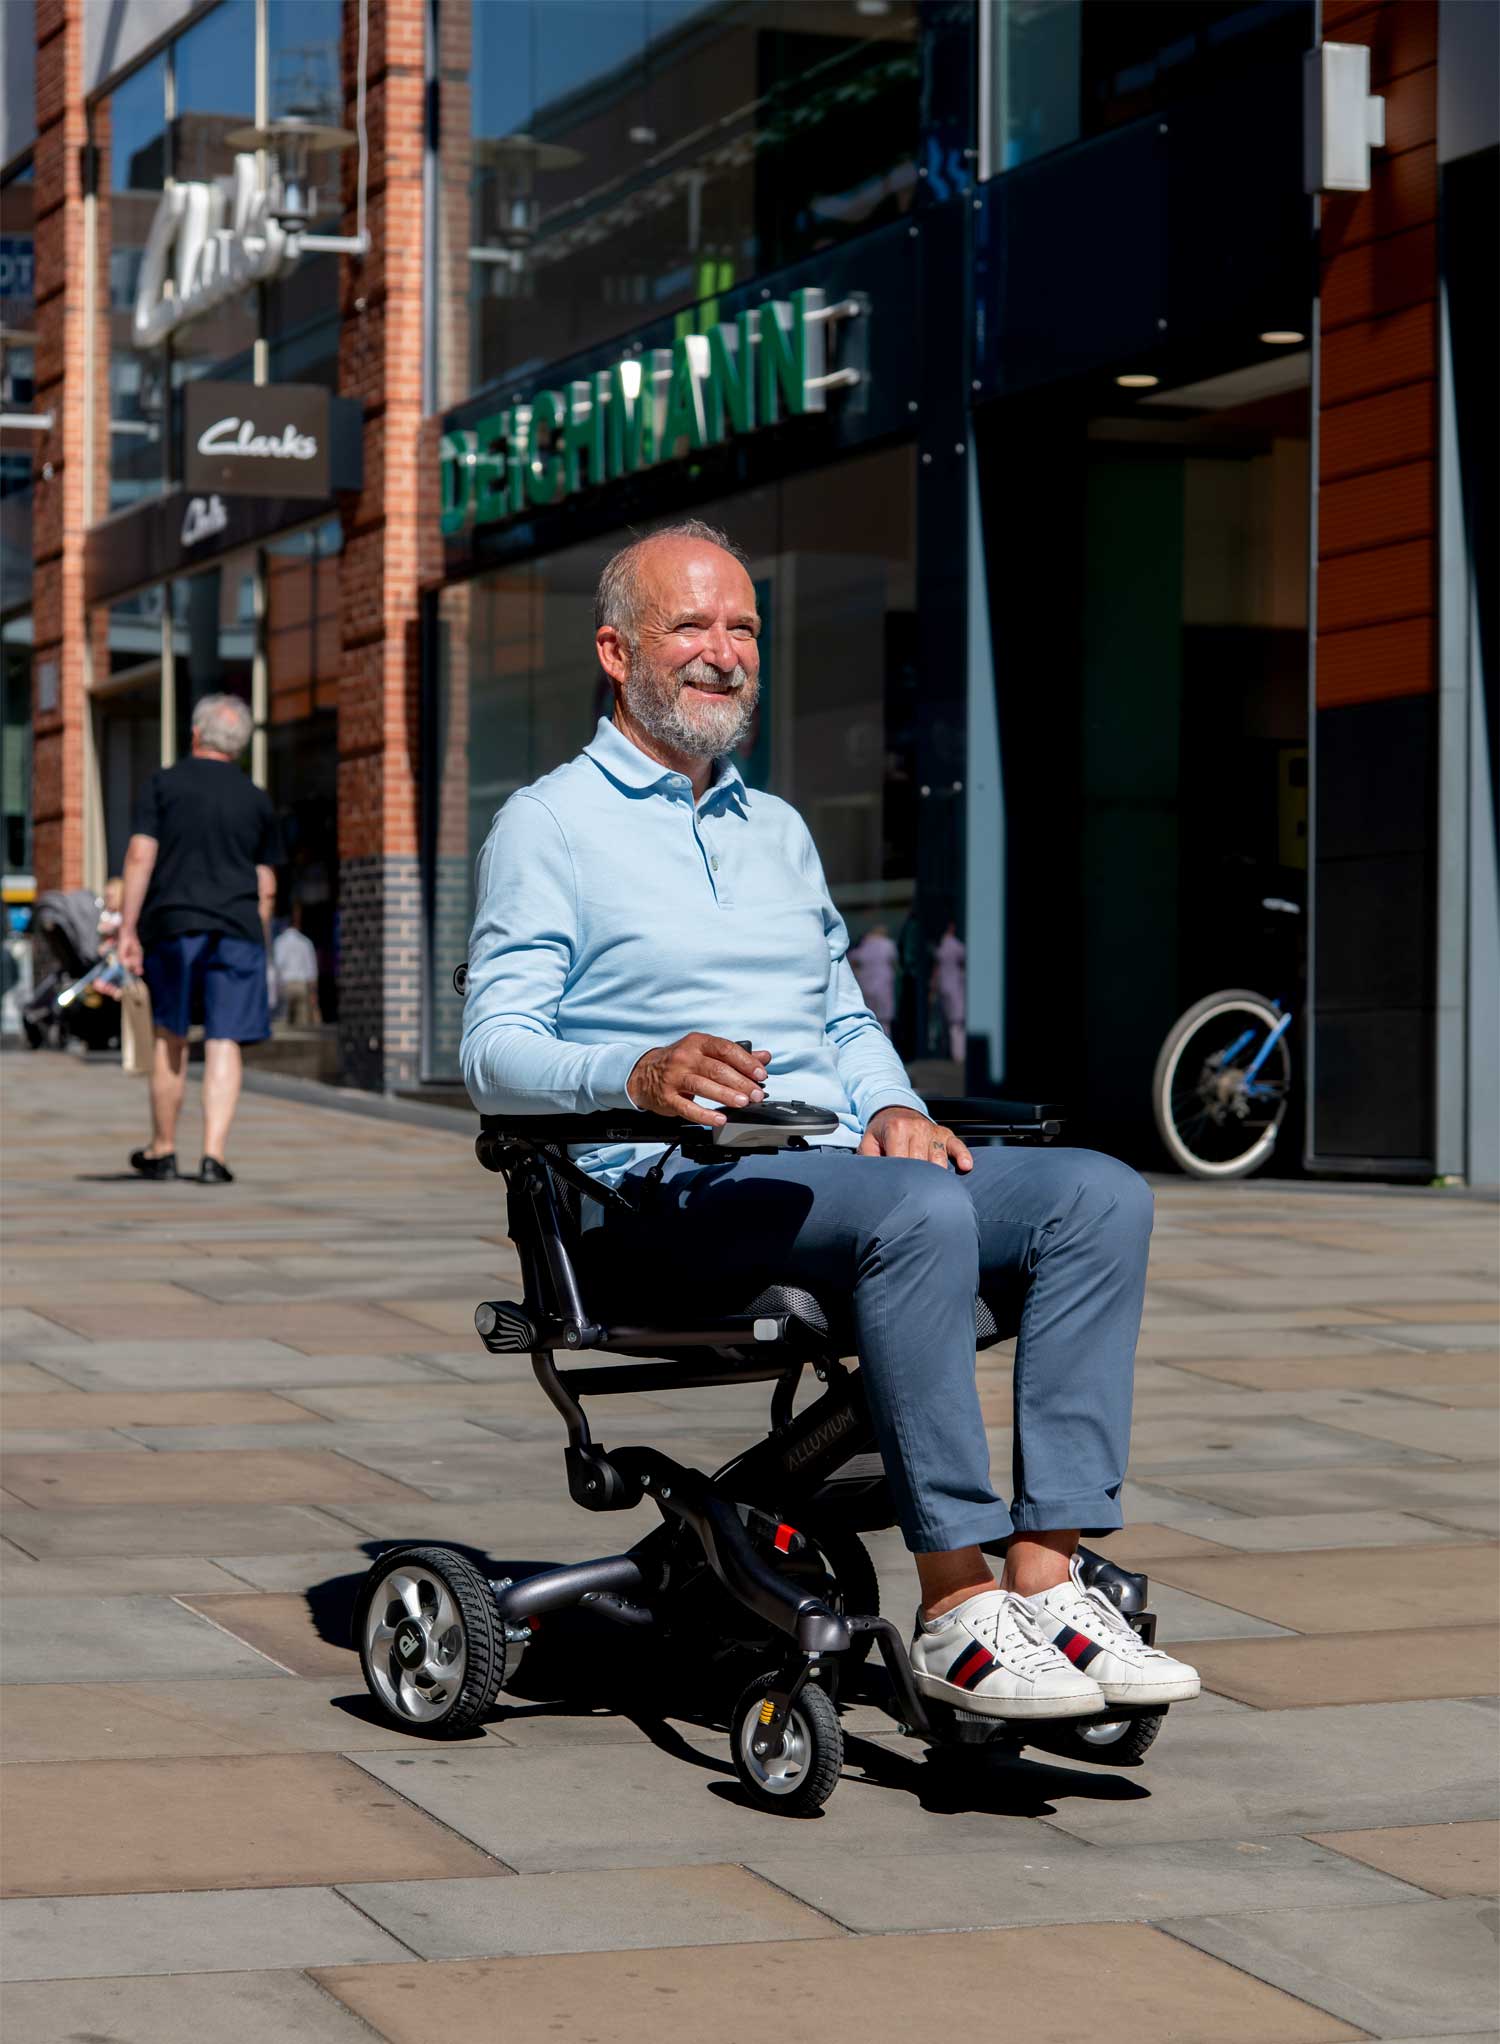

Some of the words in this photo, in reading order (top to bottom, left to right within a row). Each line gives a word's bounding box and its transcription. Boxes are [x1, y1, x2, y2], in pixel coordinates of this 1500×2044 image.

[198, 417, 318, 460] Clarks
[441, 288, 826, 535] DEICHMANN
[787, 1407, 856, 1473] ALLUVIUM
